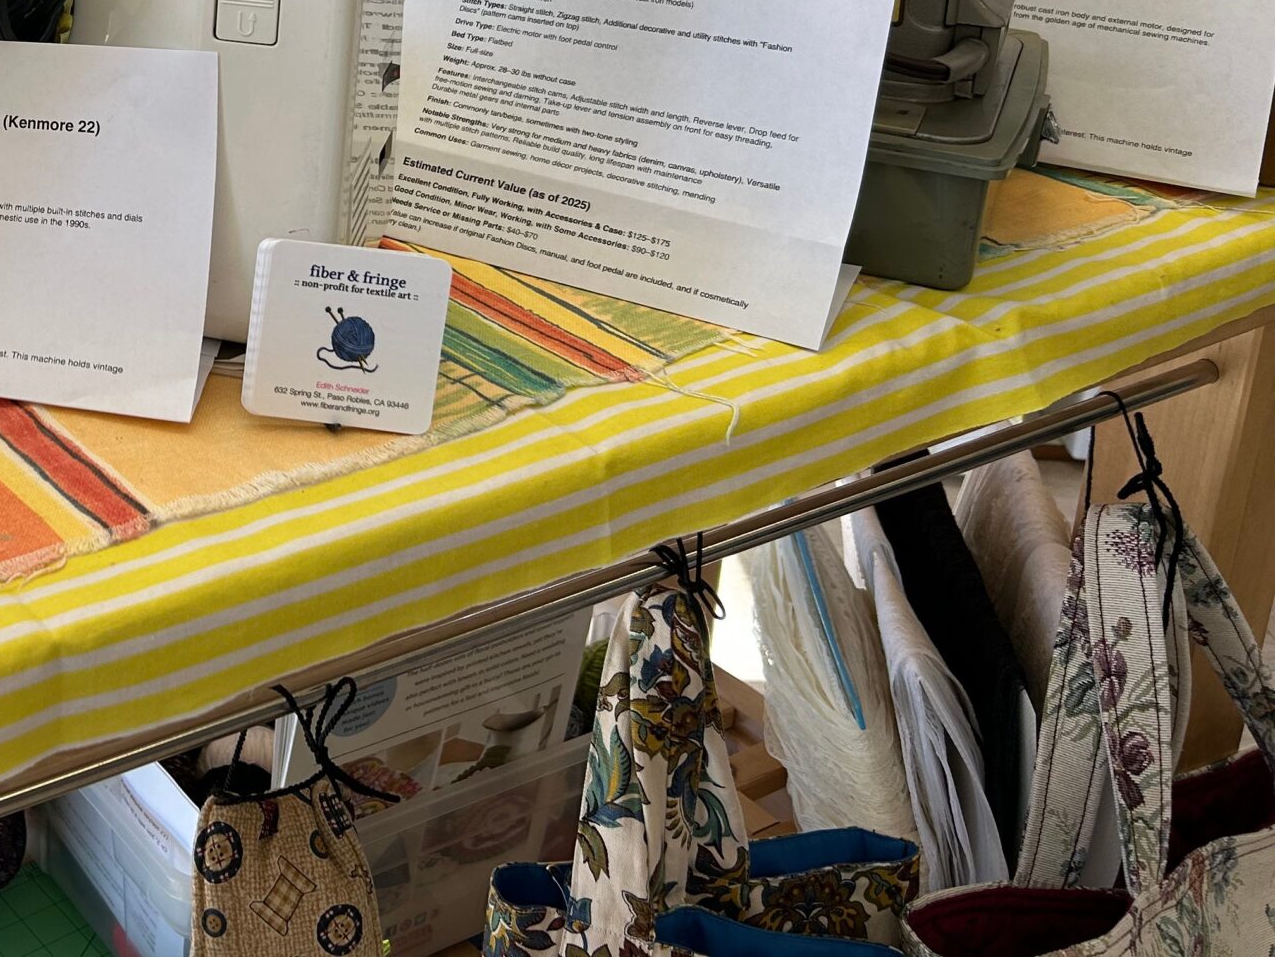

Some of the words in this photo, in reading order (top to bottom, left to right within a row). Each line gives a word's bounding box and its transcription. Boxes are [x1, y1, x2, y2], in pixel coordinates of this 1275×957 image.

[1013, 3, 1036, 11] robust
[1070, 11, 1090, 20] body
[1107, 17, 1138, 26] external
[1139, 22, 1164, 31] motor,
[1166, 25, 1202, 36] designed
[3, 114, 73, 131] (Kenmore
[77, 120, 100, 136] 22)
[402, 156, 453, 176] Estimated
[455, 169, 494, 186] Current
[497, 179, 526, 194] Value
[528, 187, 545, 199] (as
[547, 193, 560, 202] of
[560, 195, 590, 212] 2025)
[309, 265, 344, 282] fiber
[347, 269, 359, 282] &
[362, 271, 406, 290] fringe
[301, 280, 348, 292] non-profit
[350, 285, 364, 293] for
[366, 287, 396, 297] textile
[397, 292, 411, 300] art
[315, 380, 333, 390] Edith
[334, 383, 369, 394] Schneider
